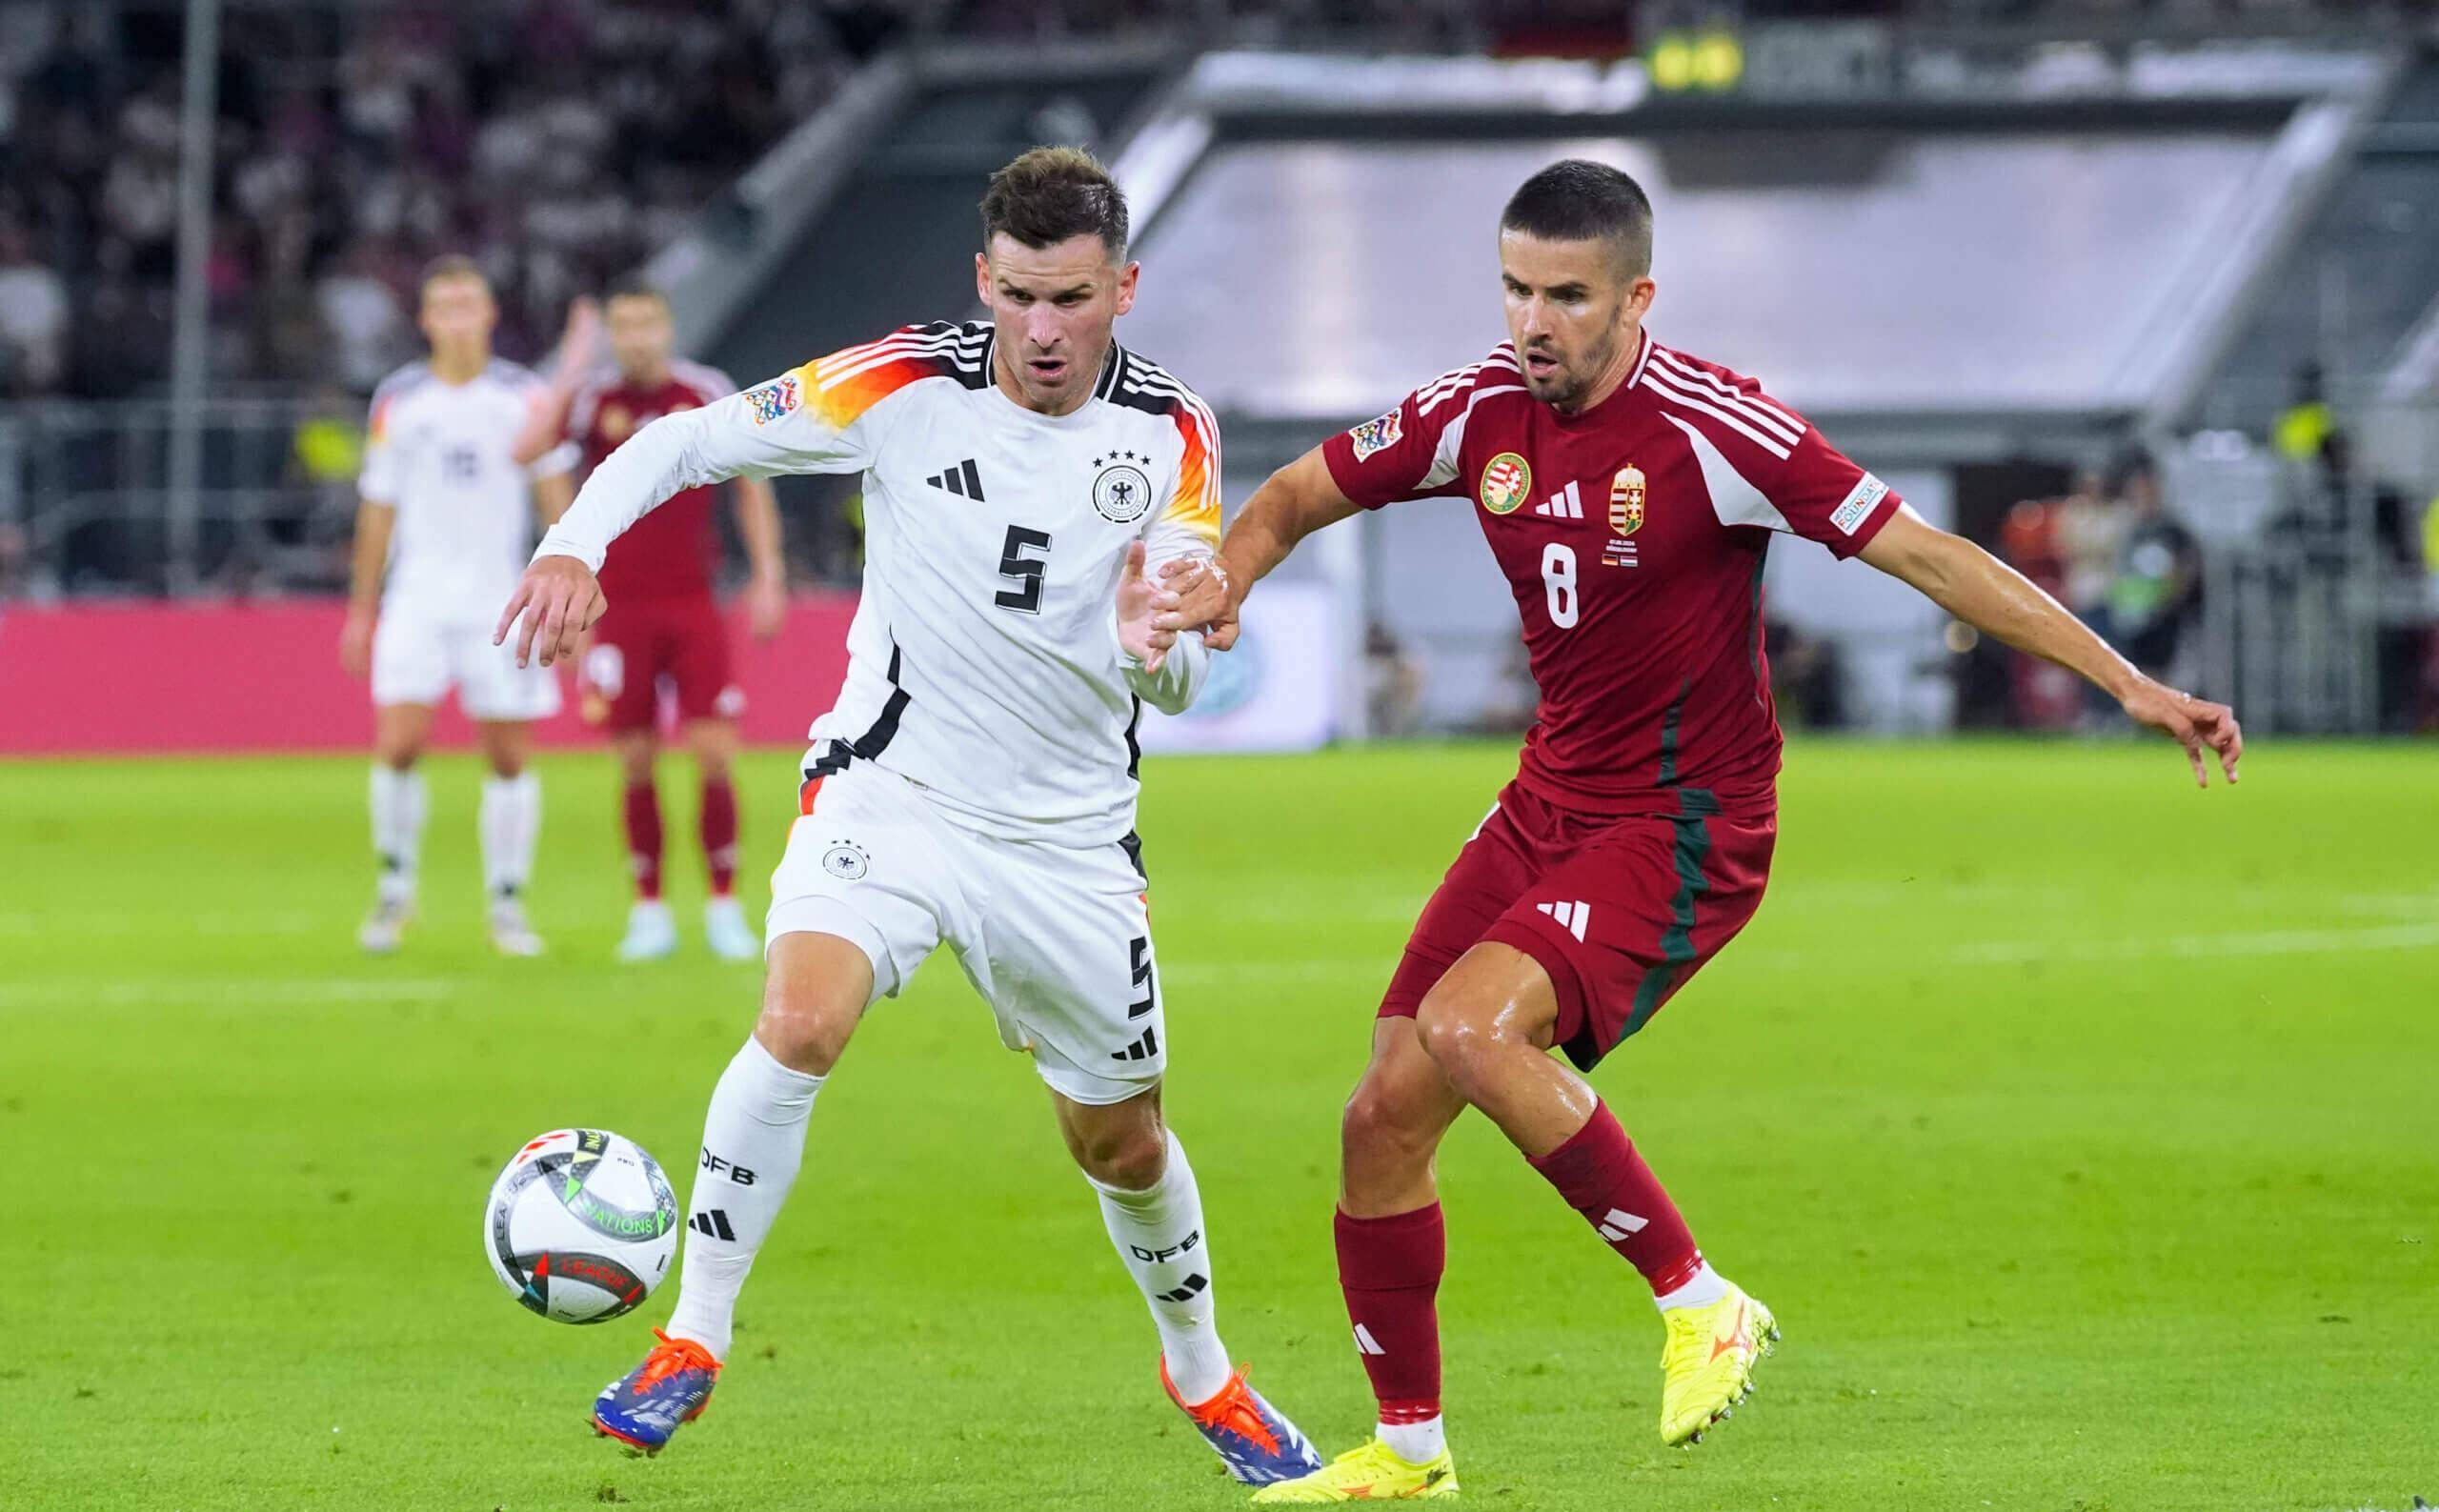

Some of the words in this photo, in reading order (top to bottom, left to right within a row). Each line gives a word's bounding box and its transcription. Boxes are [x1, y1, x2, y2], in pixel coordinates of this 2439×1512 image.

[995, 524, 1052, 615] 5
[1541, 542, 1580, 629] 8
[1128, 935, 1155, 1021] 5
[1130, 1230, 1199, 1263] DFB
